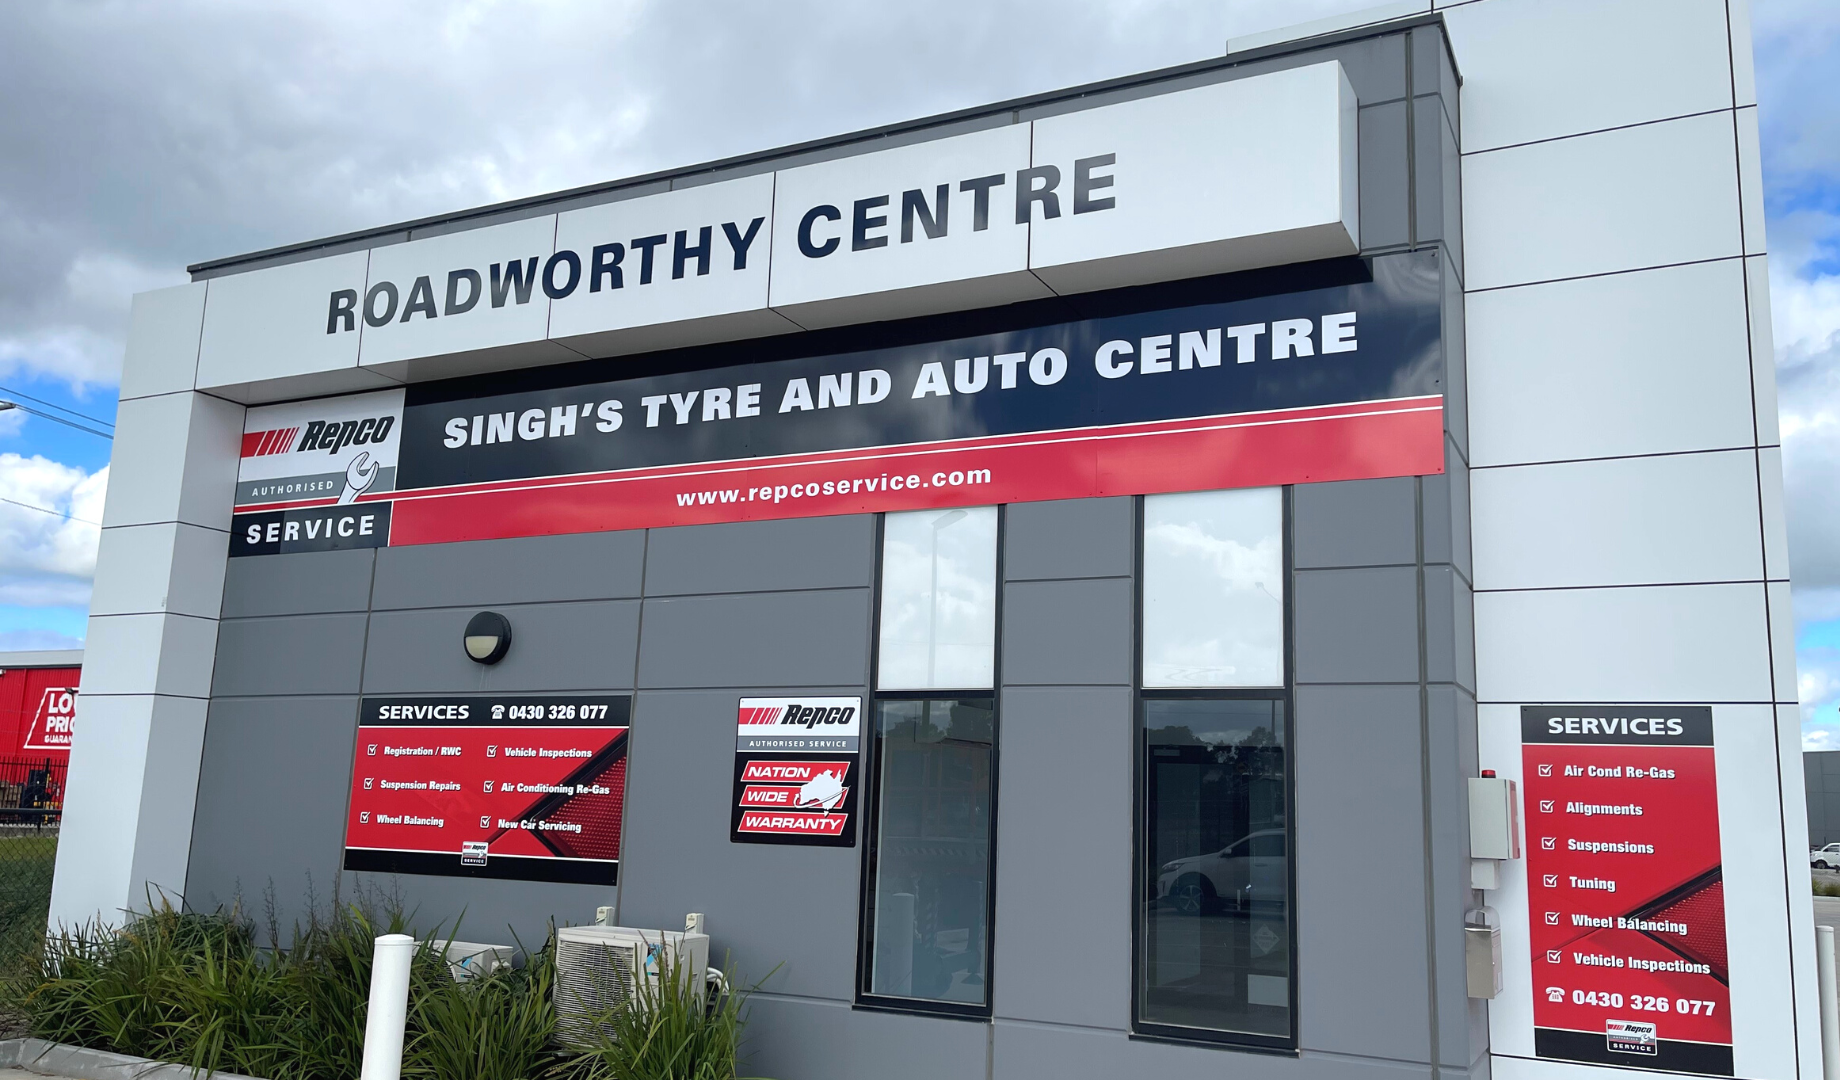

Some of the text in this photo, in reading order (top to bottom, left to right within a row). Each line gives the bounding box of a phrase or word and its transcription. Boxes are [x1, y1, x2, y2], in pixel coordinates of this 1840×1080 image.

[326, 152, 1117, 335] ROADWORTHY CENTRE
[641, 382, 762, 428] TYRE
[777, 368, 892, 414] AND
[911, 346, 1068, 400] AUTO
[1094, 310, 1359, 379] CENTRE
[296, 415, 395, 456] Repco
[251, 480, 334, 497] AUTHORISED
[676, 467, 992, 508] www.repcoservice.com
[246, 514, 375, 545] SERVICE
[48, 692, 77, 714] LO
[378, 704, 609, 721] SERVICES 0430 326 077
[781, 704, 856, 729] Repco
[1548, 716, 1684, 736] SERVICES
[384, 745, 462, 757] Registration / RWC
[749, 740, 847, 748] AUTHORISED SERVICE
[504, 747, 593, 760] Vehicle Inspections
[747, 766, 811, 778] NATION
[1564, 764, 1676, 779] Air Cond Re-Gas
[380, 779, 461, 793] Suspension Repairs
[501, 782, 610, 796] Air Conditioning Re-Gas
[747, 791, 790, 803] WIDE
[1566, 801, 1643, 817] Alignments
[377, 814, 444, 828] Wheel Balancing
[498, 819, 582, 834] New Car Servicing
[745, 816, 842, 831] WARRANTY
[1567, 838, 1655, 855] Suspensions
[1569, 876, 1616, 892] Tuning
[1571, 914, 1688, 936] Wheel Balancing
[1573, 952, 1711, 975] Vehicle Inspections
[1572, 989, 1716, 1017] 0430 326 077
[1624, 1024, 1652, 1034] Repco
[1613, 1043, 1652, 1052] SERVICE
